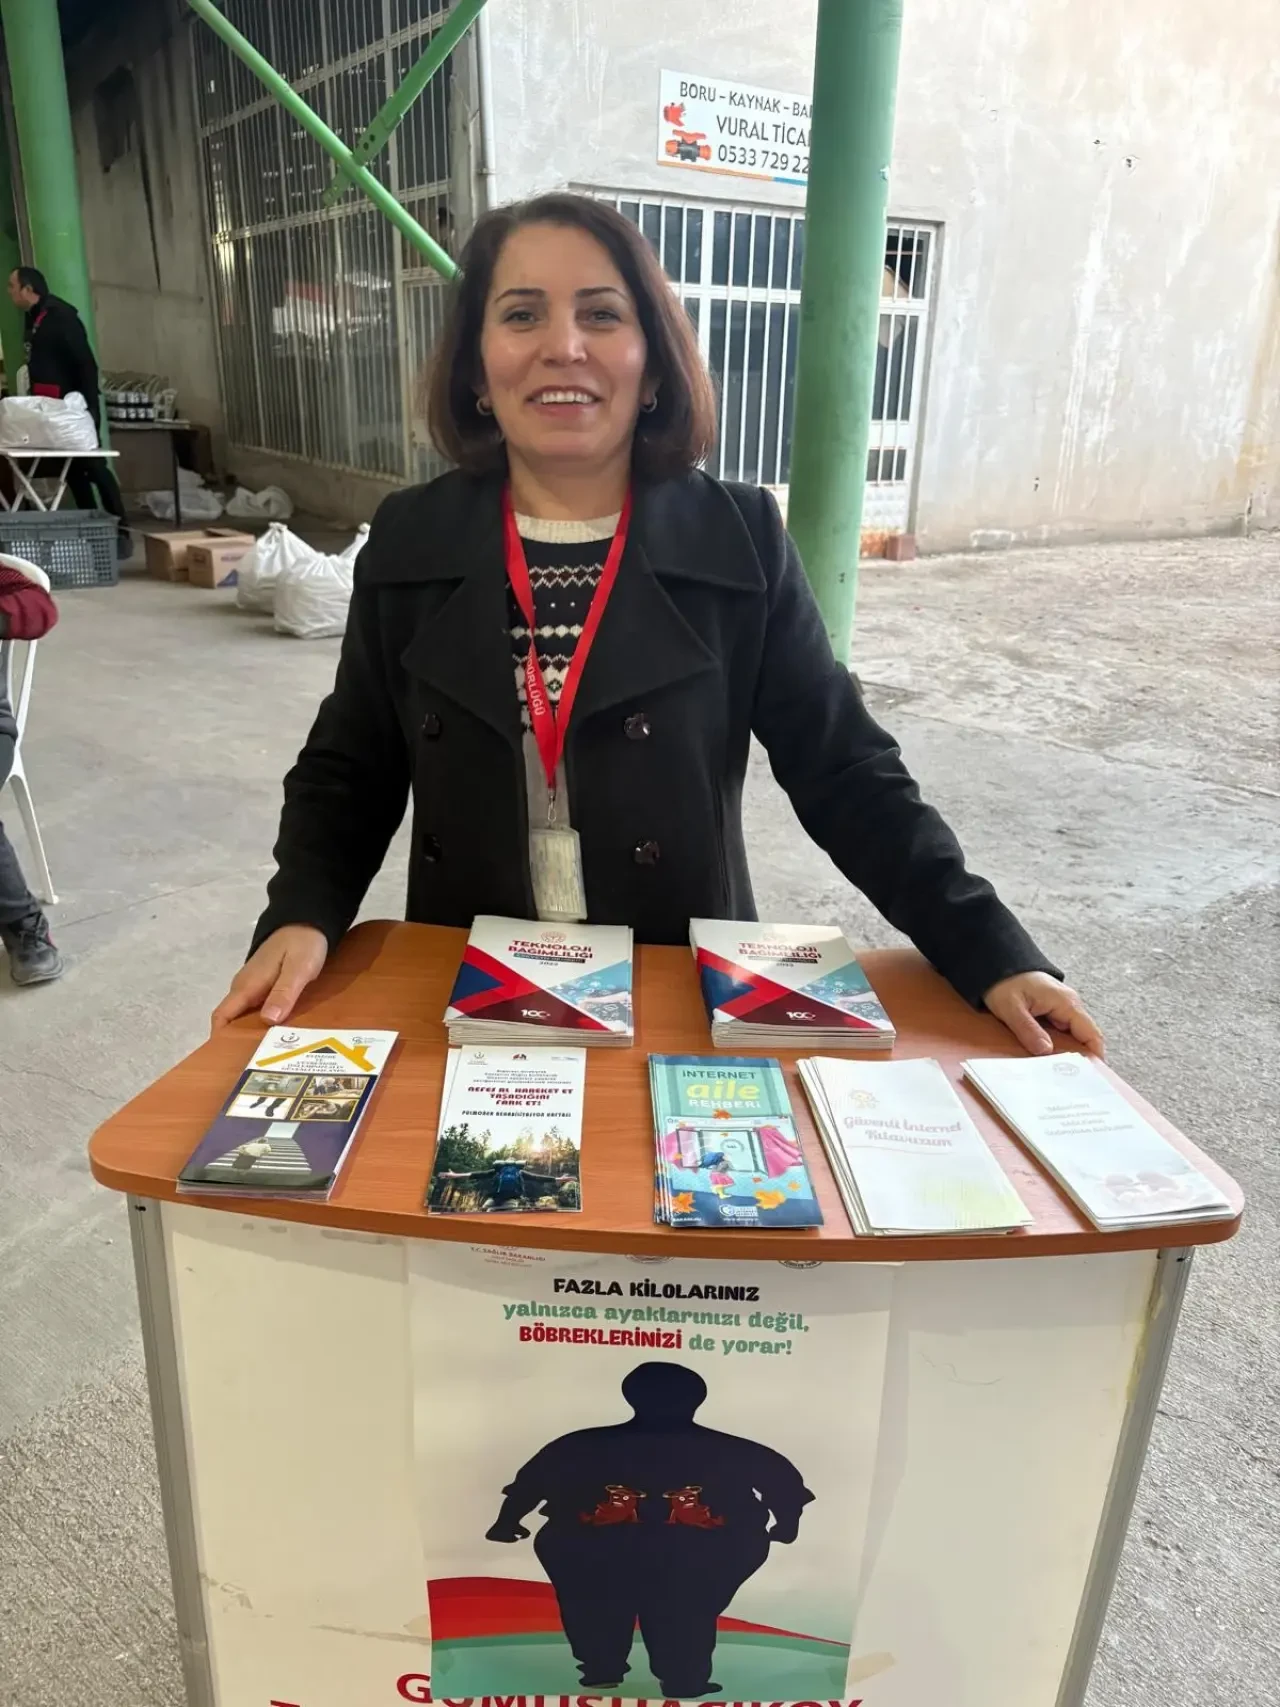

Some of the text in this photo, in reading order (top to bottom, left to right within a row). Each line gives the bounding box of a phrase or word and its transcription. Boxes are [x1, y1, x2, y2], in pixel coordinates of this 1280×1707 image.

[680, 81, 716, 102] BORU
[729, 91, 781, 113] KAYNAK
[716, 115, 769, 141] VURAL
[718, 144, 757, 166] 0533
[761, 150, 789, 170] 729
[686, 1080, 760, 1100] aile
[553, 1278, 760, 1302] FAZLA KİLOLARINIZ
[502, 1300, 810, 1333] yalnızca ayaklarınızı değil,
[519, 1322, 793, 1356] BÖBREKLERİNİZİ de yorar!
